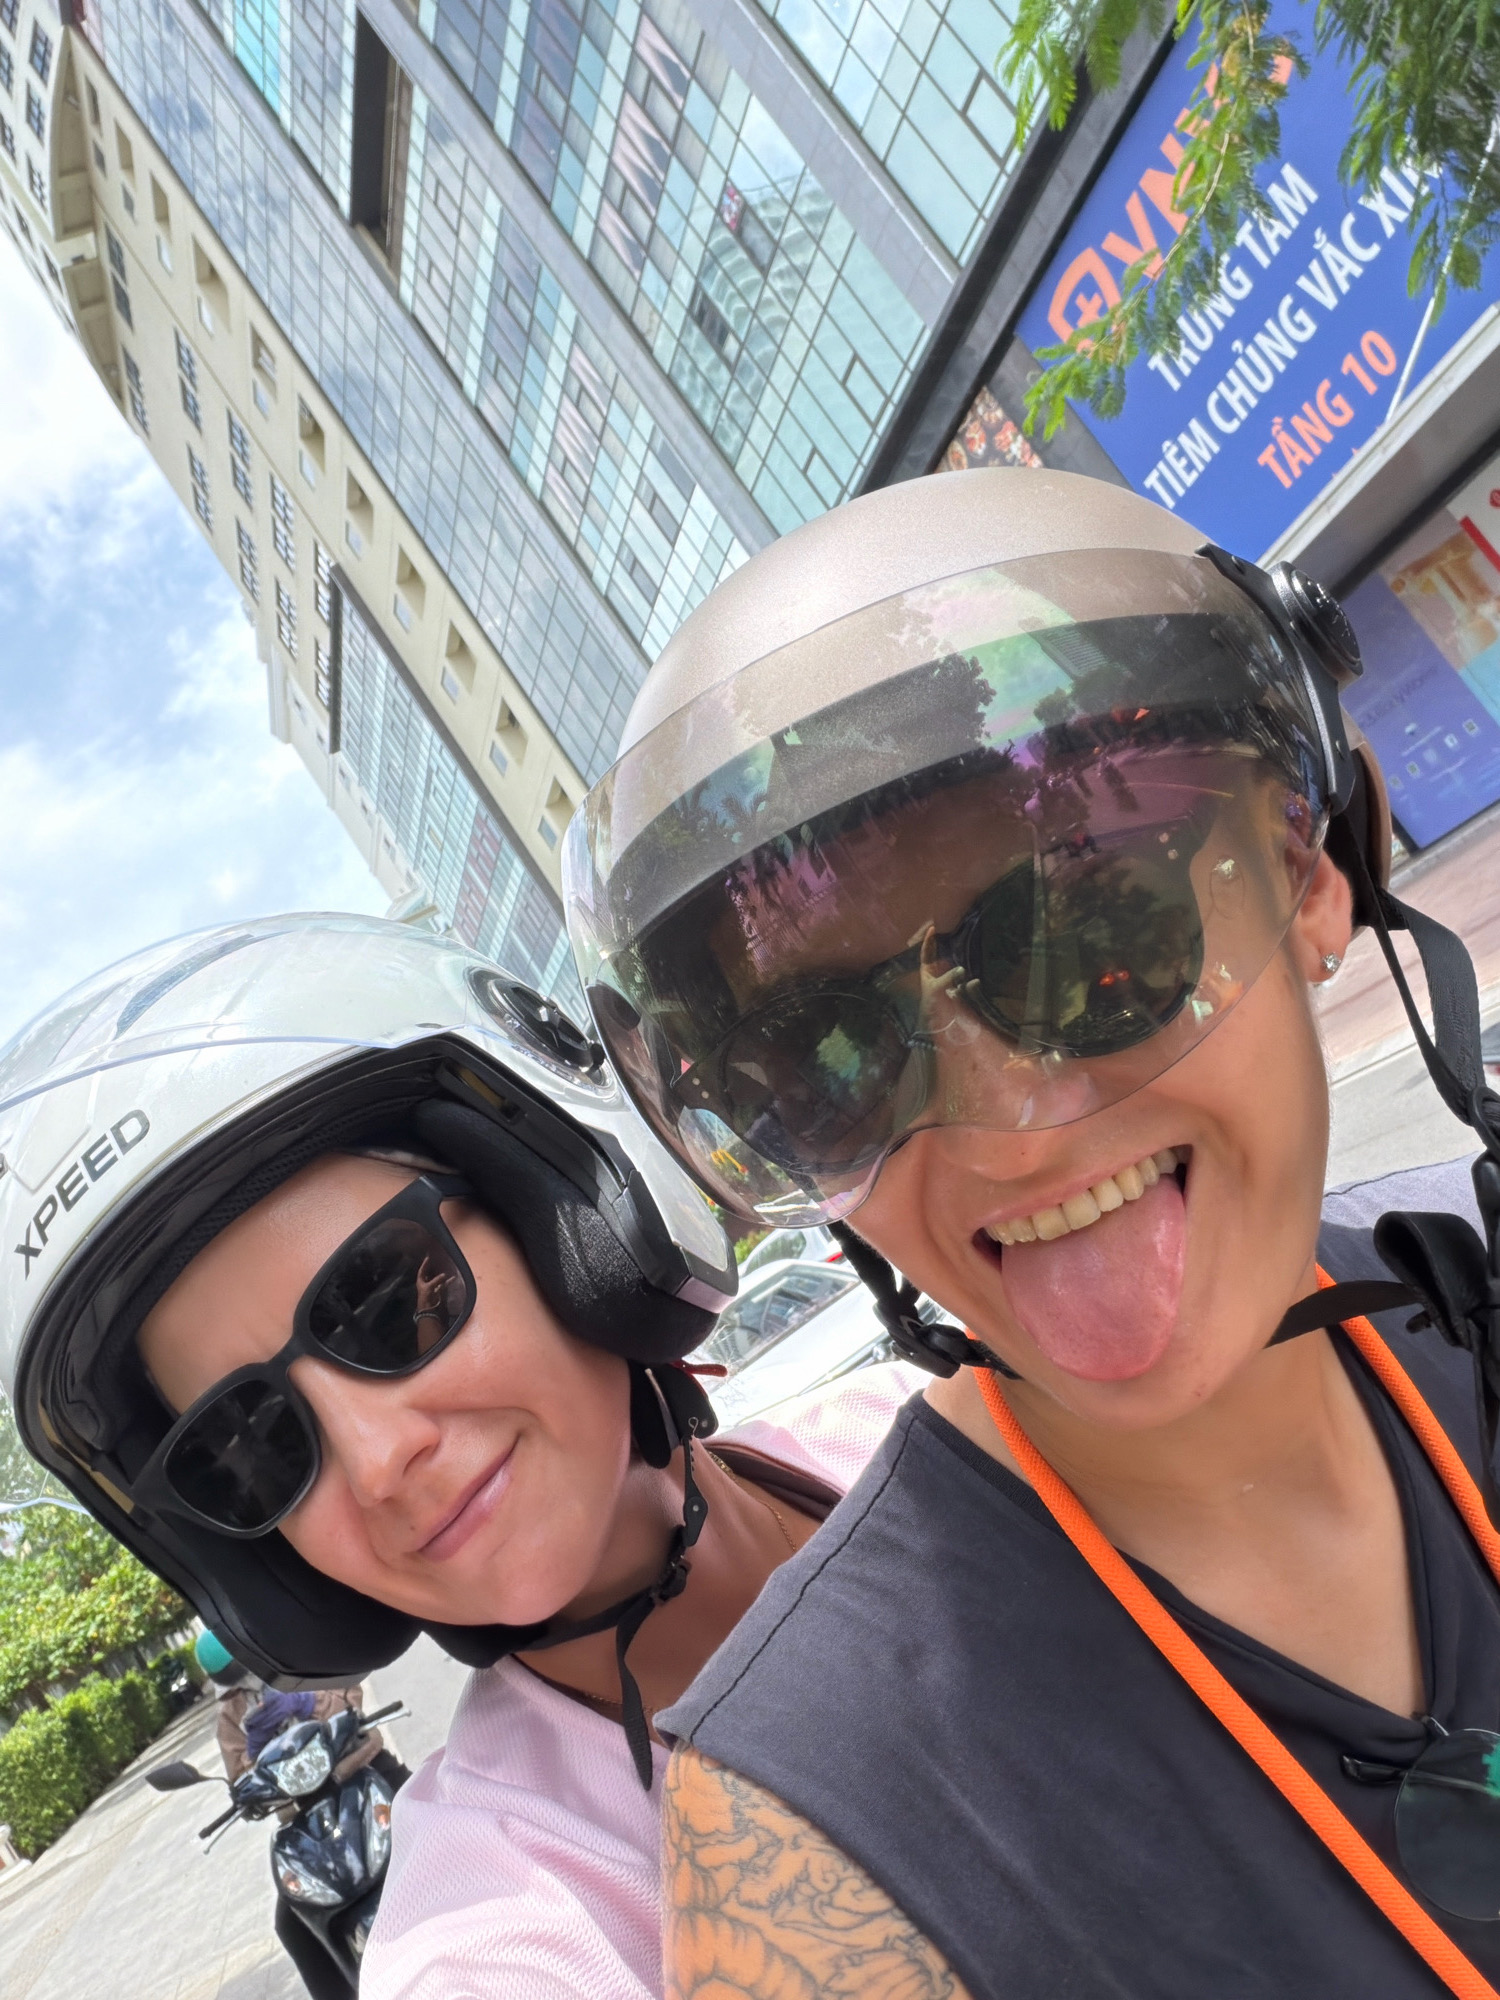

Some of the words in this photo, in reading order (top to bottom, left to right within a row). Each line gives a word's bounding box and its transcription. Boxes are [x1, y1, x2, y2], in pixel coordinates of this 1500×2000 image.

[1101, 35, 1293, 280] VN
[1143, 417, 1220, 509] TIÊM
[1207, 294, 1317, 433] CHỦNG
[1295, 212, 1381, 311] VẮC
[1257, 378, 1354, 489] TẦNG
[1341, 330, 1397, 396] 10
[14, 1109, 150, 1281] XPEED
